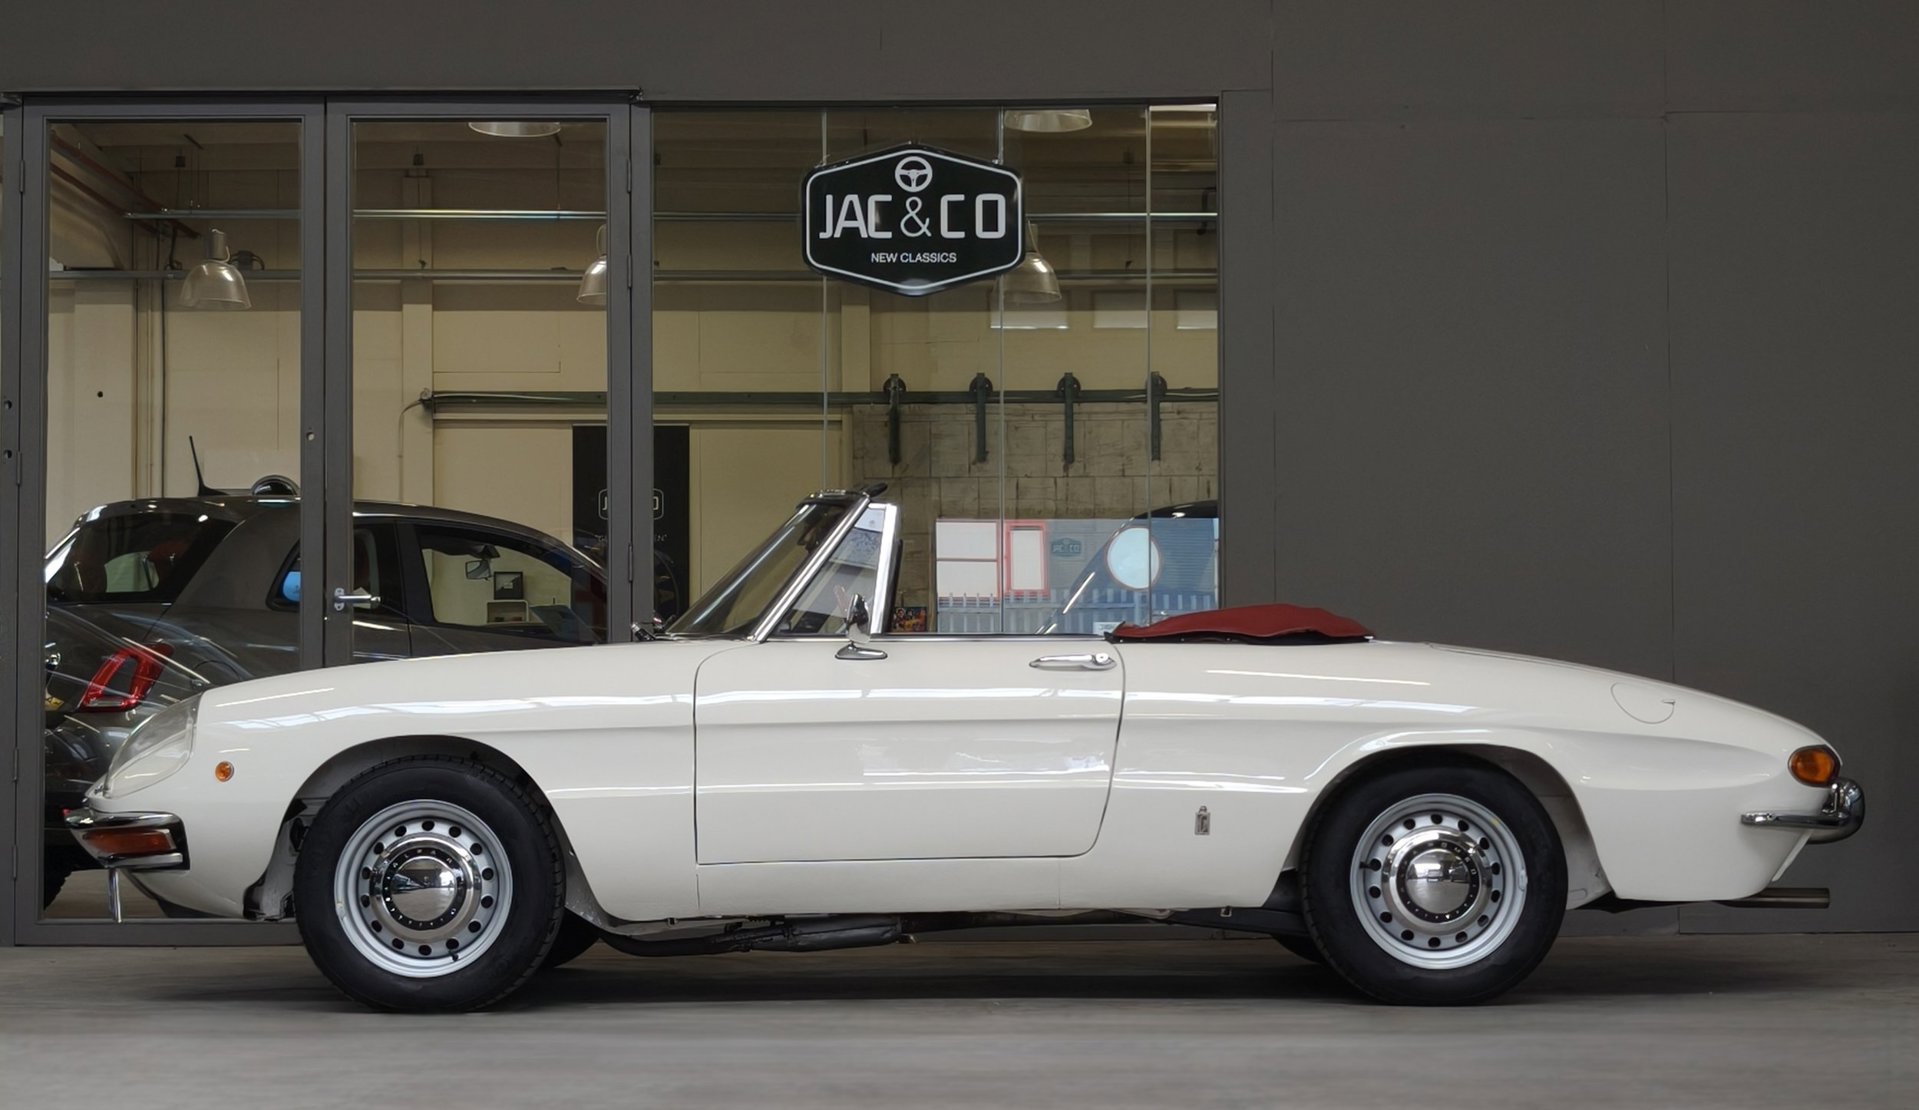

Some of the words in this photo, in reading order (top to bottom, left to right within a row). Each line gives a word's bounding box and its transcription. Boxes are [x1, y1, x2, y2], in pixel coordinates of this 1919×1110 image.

[819, 194, 893, 239] JAC
[900, 196, 932, 238] &
[870, 252, 898, 263] NEW
[900, 252, 957, 263] CLASSICS
